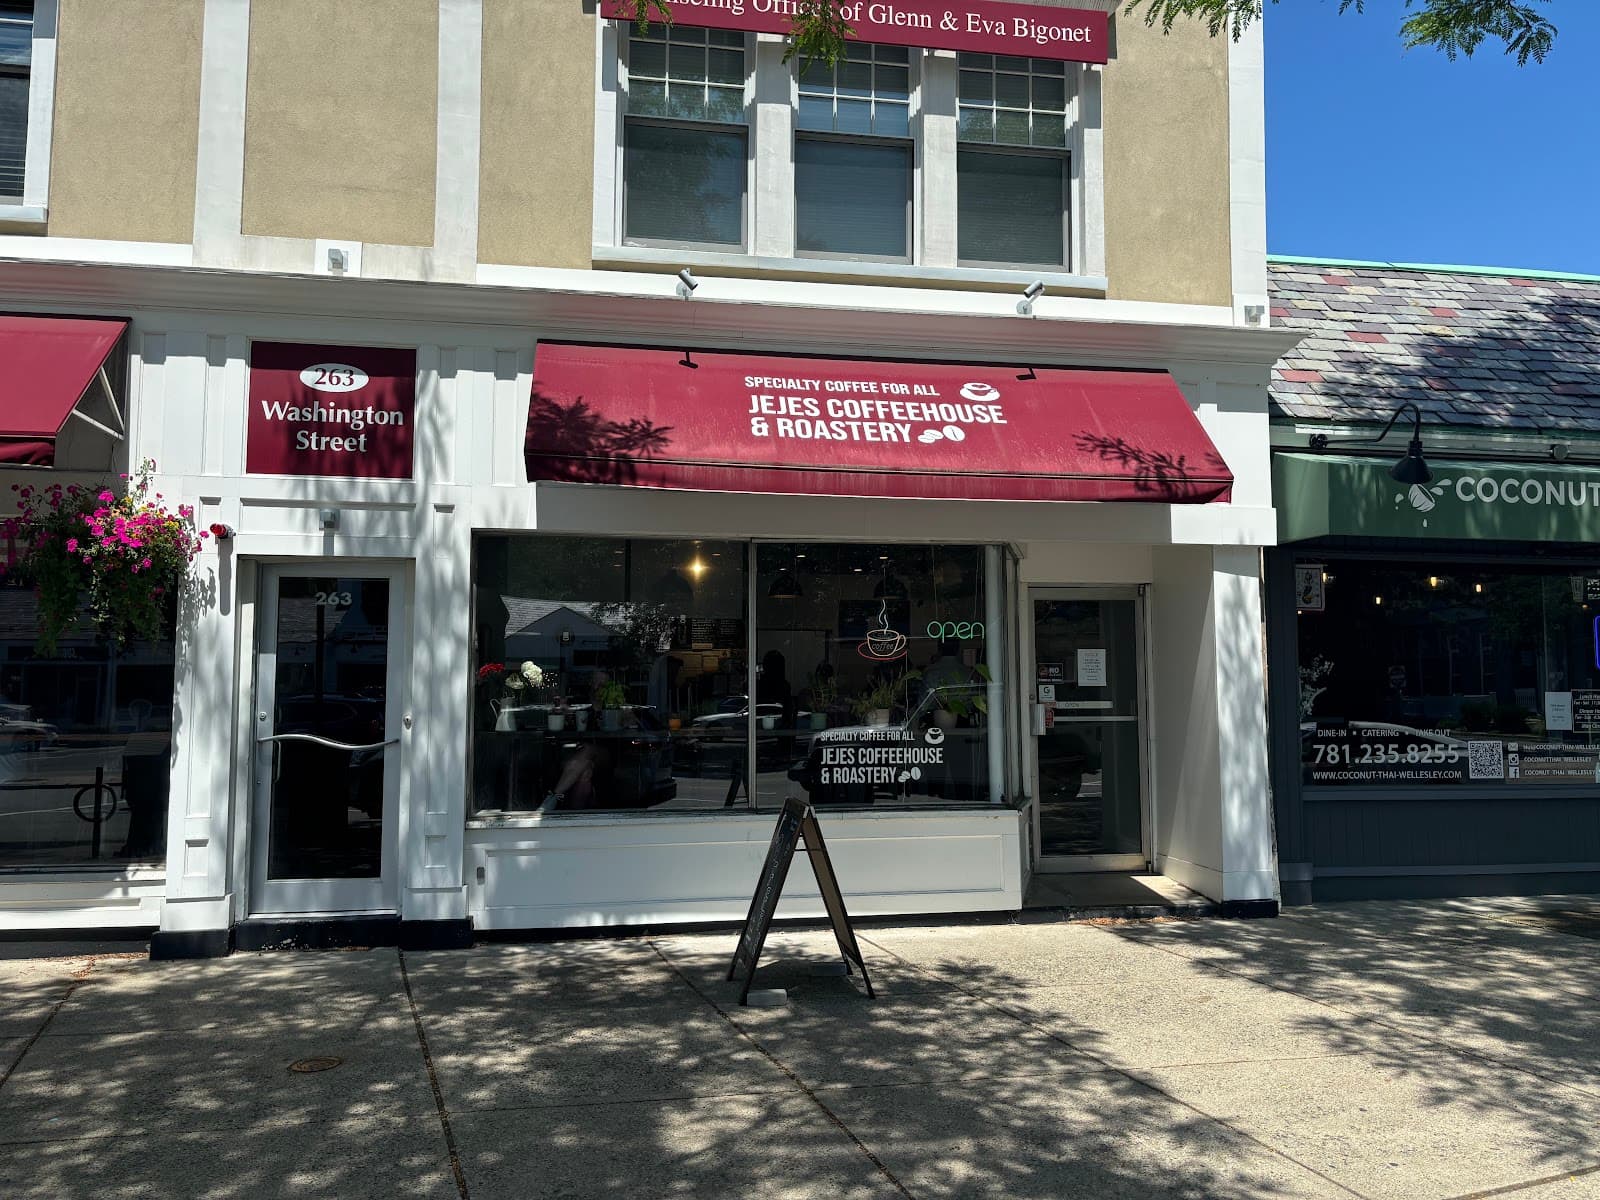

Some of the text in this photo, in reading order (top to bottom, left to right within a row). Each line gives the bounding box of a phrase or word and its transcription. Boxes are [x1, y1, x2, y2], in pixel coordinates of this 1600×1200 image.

[839, 2, 863, 21] of
[868, 3, 932, 29] Glenn
[939, 11, 959, 31] &
[966, 13, 1006, 36] Eva
[1013, 18, 1092, 44] Bigonet
[313, 367, 355, 387] 263
[744, 376, 940, 396] SPECIALTY COFFEE FOR ALL
[261, 400, 404, 430] Washington
[748, 394, 1008, 424] JEJES COFFEEHOUSE
[751, 417, 912, 443] & ROASTERY
[296, 430, 368, 453] Street
[1455, 476, 1600, 507] COCONUT
[315, 592, 352, 606] 263
[820, 731, 916, 741] SPECIALTY COFFEE FOR ALL
[1317, 729, 1347, 737] DINE-IN
[1361, 729, 1400, 737] CATERING
[820, 748, 944, 765] JEJES COFFEEHOUSE
[1312, 744, 1460, 764] 781.235.8255
[821, 767, 897, 784] & ROASTERY
[1312, 771, 1462, 780] WWW.COCONUT-THAI-WELLESLEY.COM
